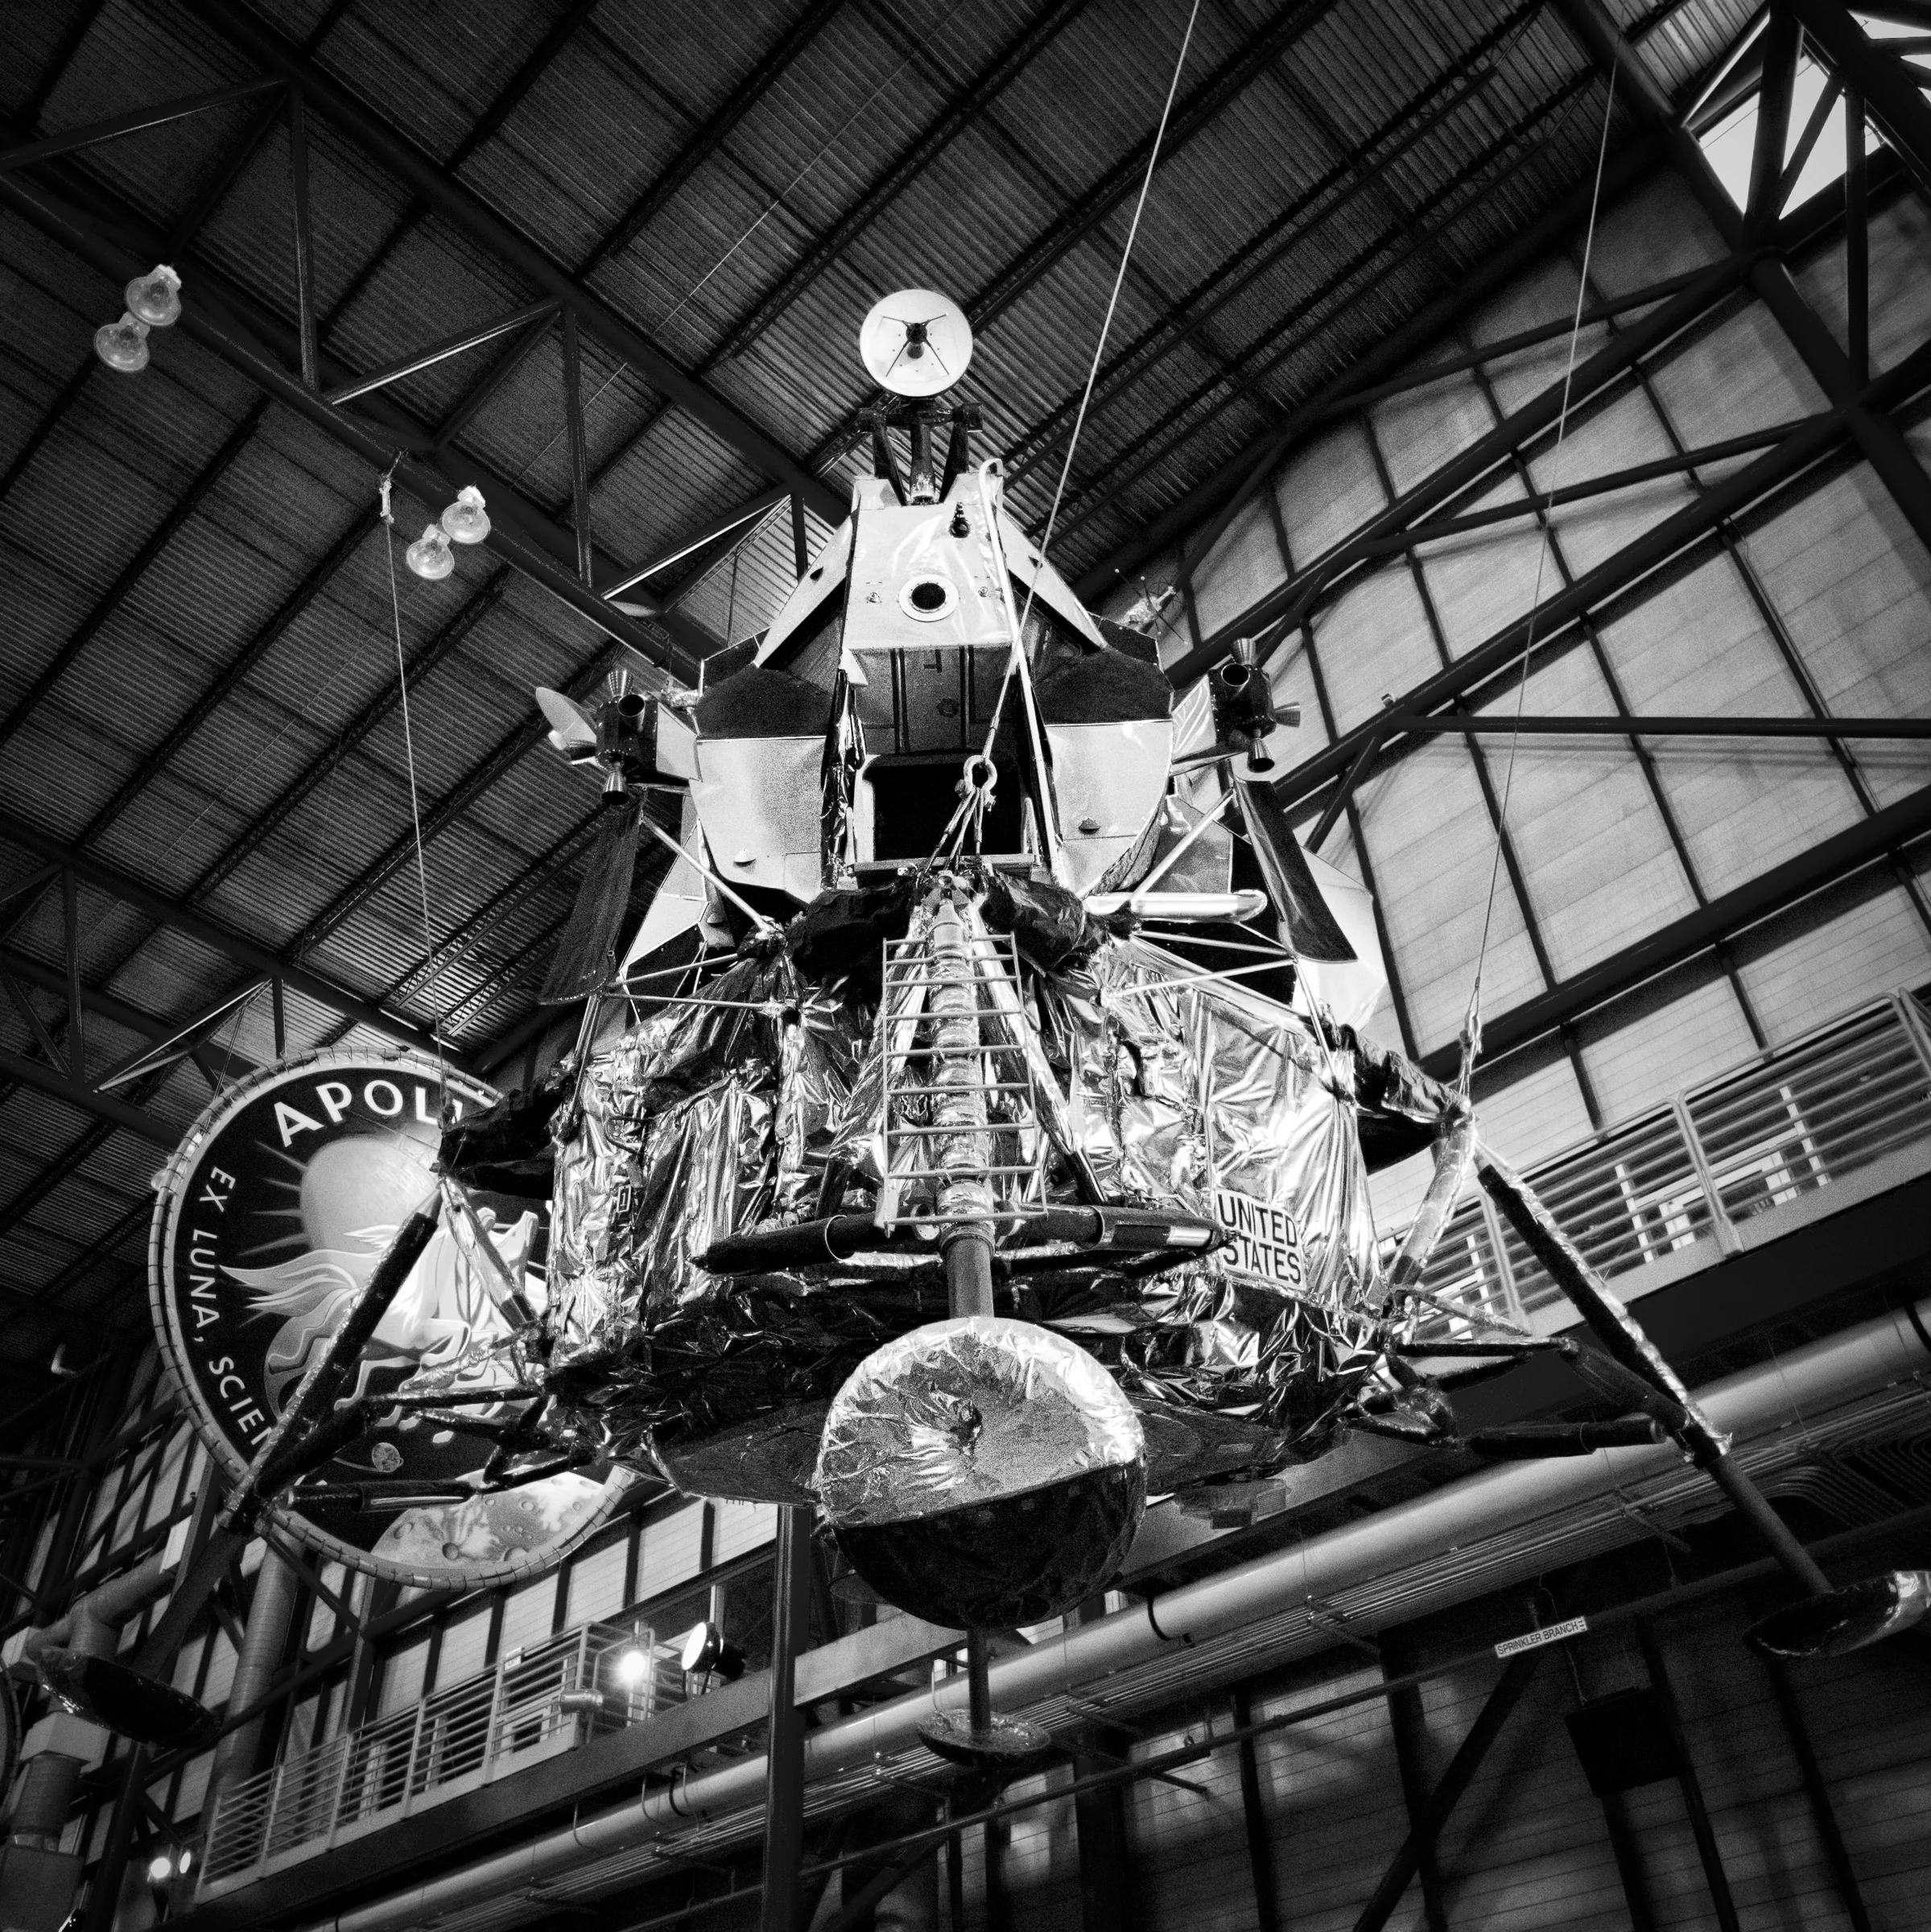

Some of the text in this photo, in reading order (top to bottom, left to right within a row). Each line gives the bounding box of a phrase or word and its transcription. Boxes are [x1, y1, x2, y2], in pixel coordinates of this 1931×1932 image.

[200, 1166, 236, 1212] EX
[1217, 1194, 1298, 1248] UNITED
[189, 1228, 220, 1342] LUNA,
[1223, 1234, 1302, 1285] STATES
[1497, 1620, 1578, 1655] SPRINKLER BRANCH
